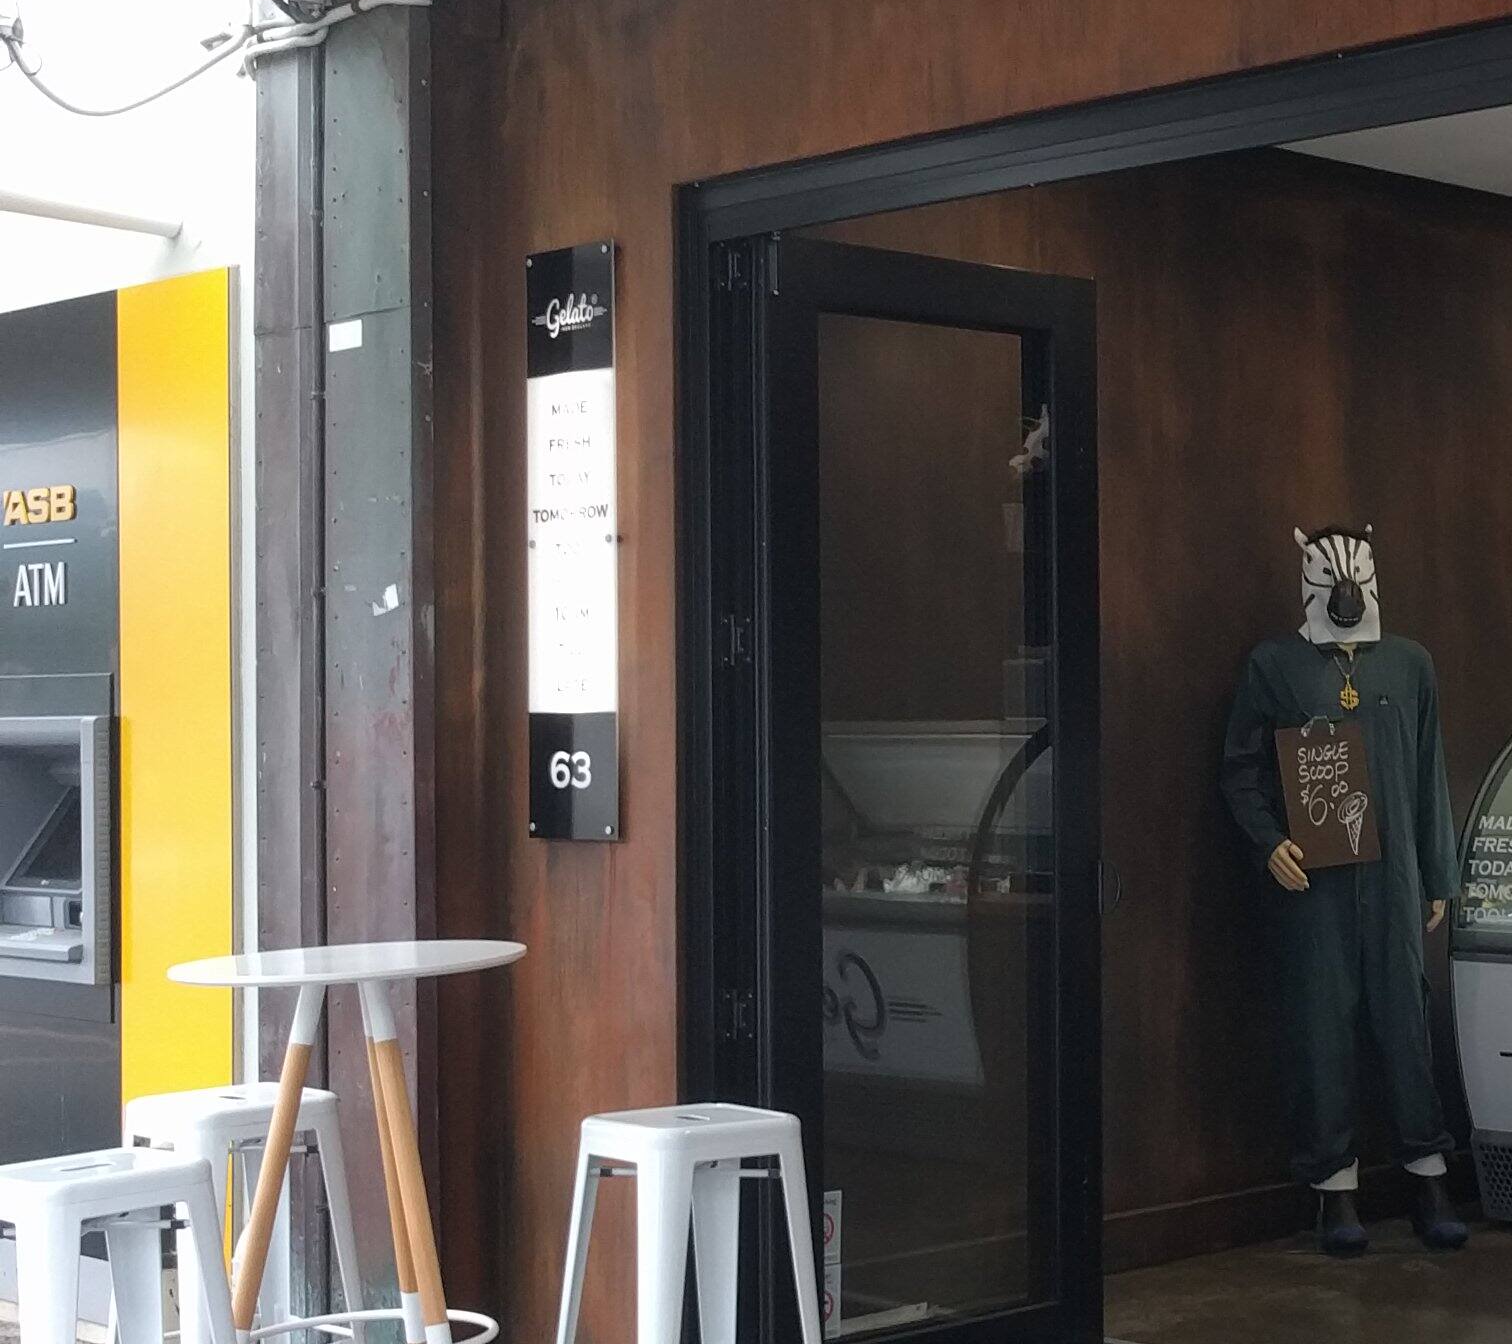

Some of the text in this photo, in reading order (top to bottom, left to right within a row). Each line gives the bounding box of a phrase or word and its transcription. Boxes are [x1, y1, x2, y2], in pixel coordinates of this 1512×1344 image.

[546, 293, 594, 339] Gelato
[4, 484, 77, 526] ASB
[13, 561, 67, 607] ATM
[551, 750, 592, 789] 63
[1297, 740, 1349, 764] SINGLE
[1298, 761, 1349, 783] SCOOP
